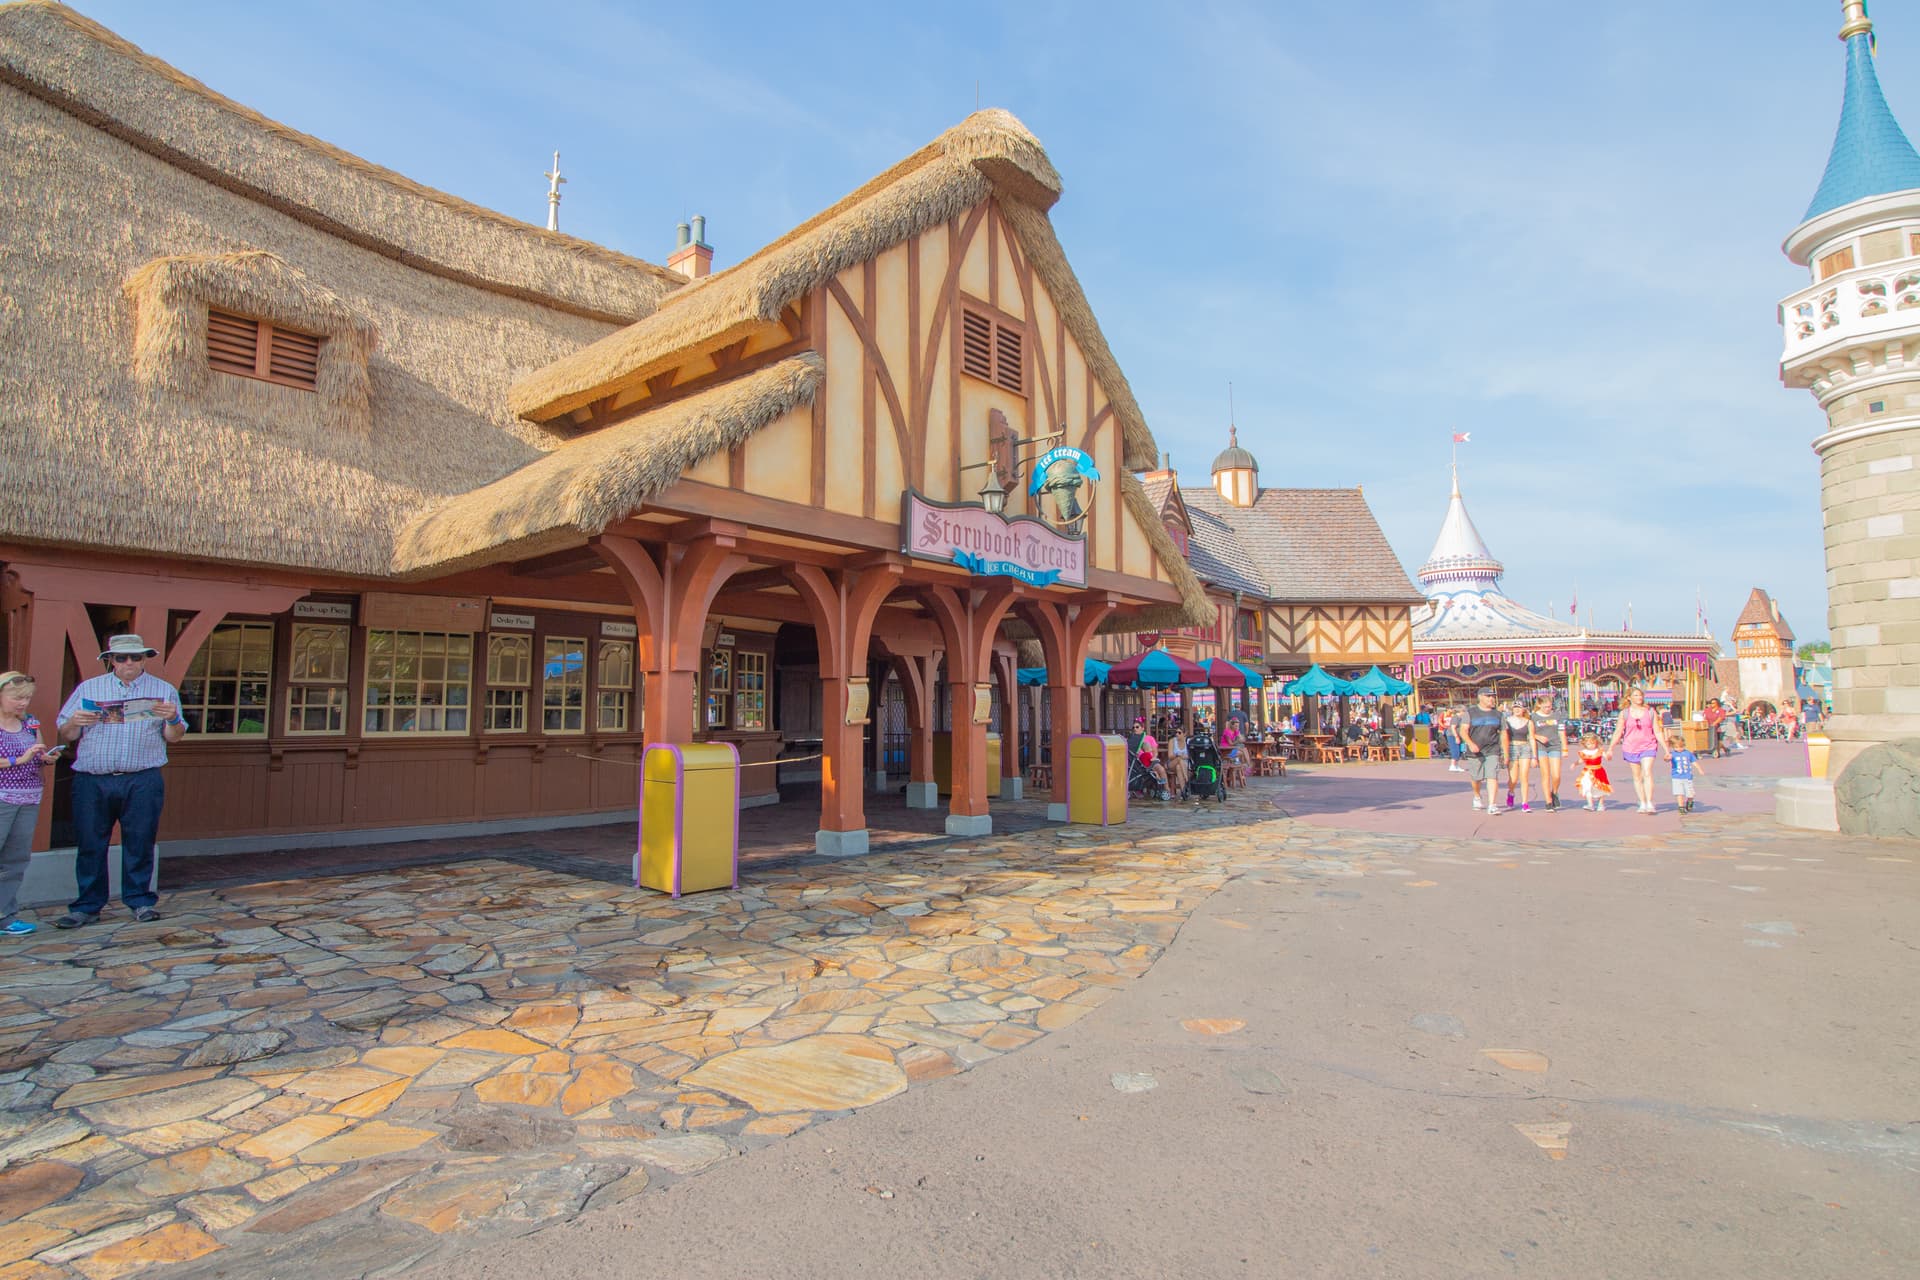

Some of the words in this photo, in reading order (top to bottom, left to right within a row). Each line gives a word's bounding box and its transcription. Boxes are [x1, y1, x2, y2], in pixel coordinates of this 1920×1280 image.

[919, 511, 1022, 560] Storybook
[1026, 534, 1077, 570] Treats
[987, 562, 999, 573] ICE
[1002, 562, 1034, 581] CREAM
